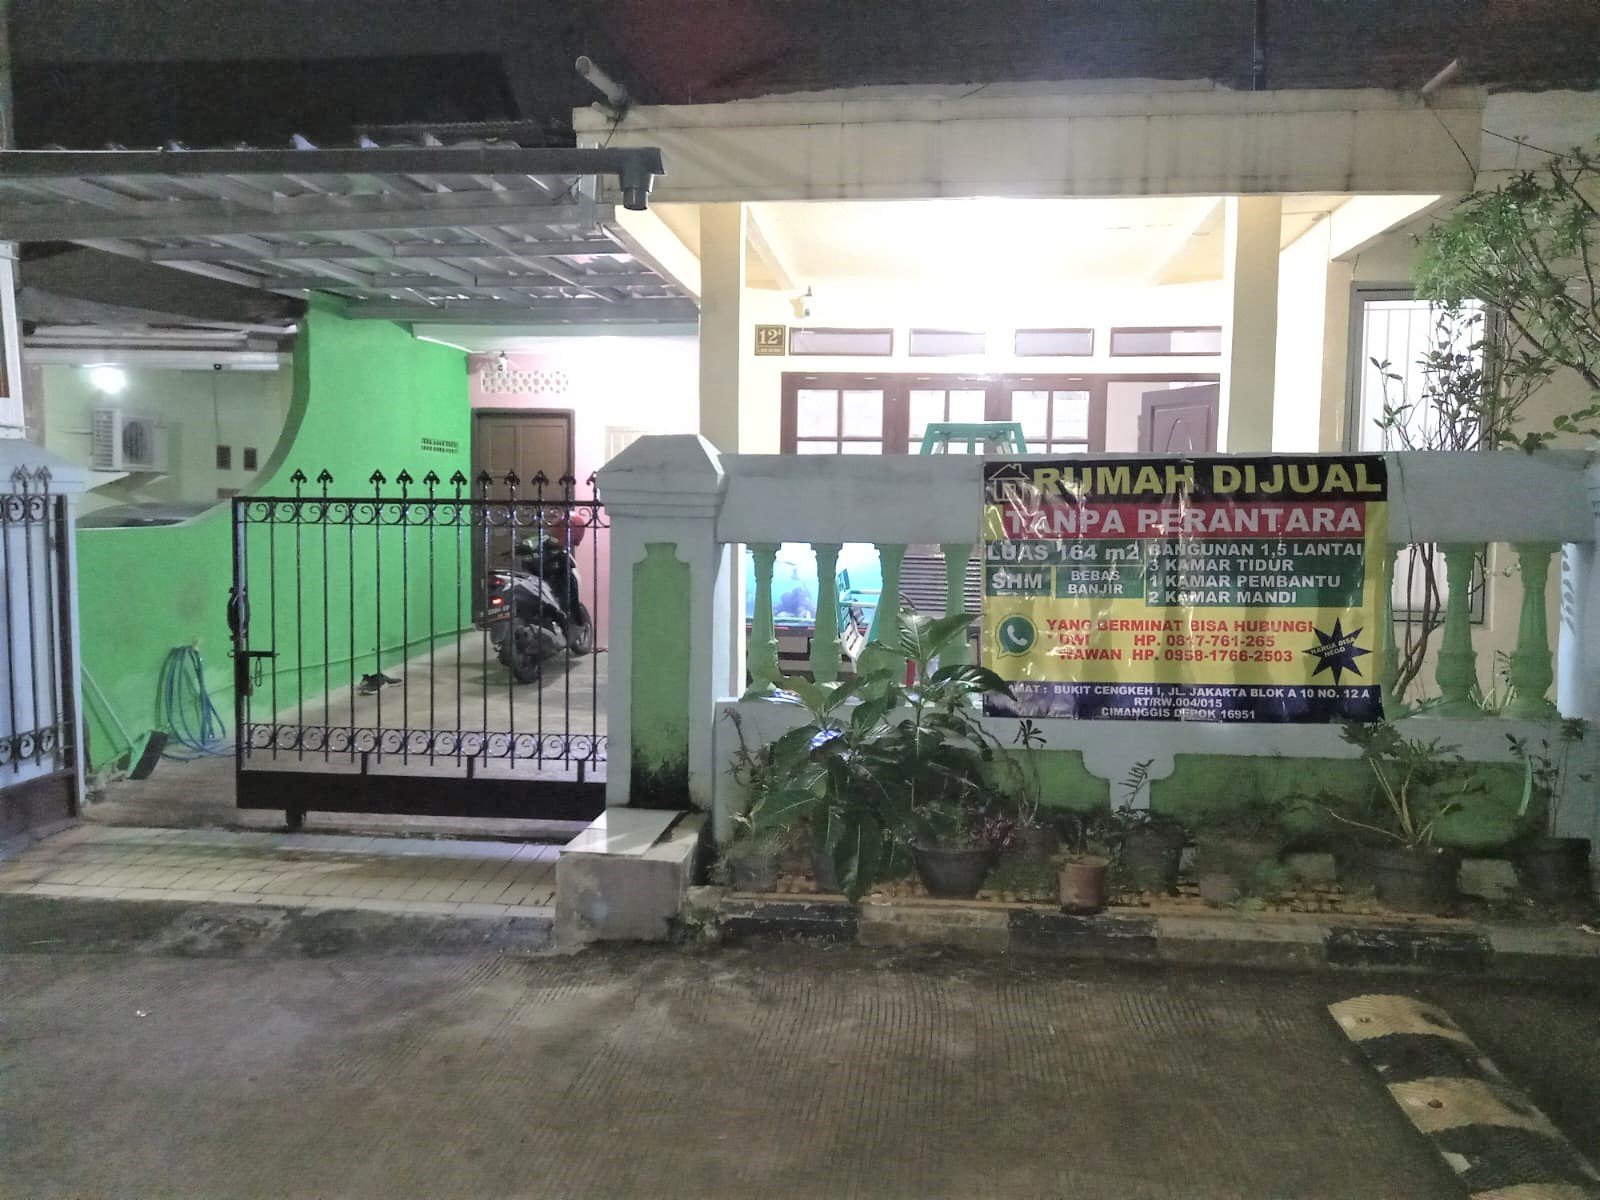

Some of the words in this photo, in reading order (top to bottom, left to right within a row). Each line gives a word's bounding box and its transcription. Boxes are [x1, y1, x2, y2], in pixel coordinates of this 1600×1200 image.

[1033, 465, 1195, 496] RUMAH
[1212, 463, 1382, 494] DIJUAL
[1005, 508, 1126, 534] TANPA
[1137, 507, 1362, 534] PERANTARA
[987, 544, 1049, 561] LUAS
[1059, 543, 1098, 561] 164
[1105, 543, 1140, 561] m2
[1150, 542, 1253, 556] BANGUNAN
[1261, 543, 1287, 559] 1,5
[1293, 543, 1362, 556] LANTAI
[1150, 560, 1160, 572] 3
[1165, 559, 1231, 572] KAMAR
[1237, 559, 1294, 572] TIDUR
[992, 573, 1042, 589] SHM
[1071, 570, 1121, 581] BEBAS
[1150, 576, 1158, 588] 1
[1165, 575, 1231, 588] KAMAR
[1237, 575, 1341, 588] PEMBANTU
[1068, 583, 1123, 595] BANJIR
[1149, 591, 1160, 603] 2
[1165, 591, 1231, 604] KAMAR
[1237, 591, 1297, 604] MANDI
[1046, 619, 1091, 631] YANG
[1097, 619, 1183, 632] BERMINAT
[1191, 620, 1228, 632] BISA
[1234, 620, 1313, 633] HUBUNGI
[1134, 635, 1161, 646] HP.
[1132, 649, 1159, 660] HP.
[1054, 685, 1091, 694] BUKIT
[1094, 686, 1153, 696] CENGKEH
[1189, 687, 1247, 698] JAKARTA
[1250, 688, 1285, 698] BLOK
[1287, 688, 1297, 698] A
[1300, 688, 1314, 698] 10
[1317, 689, 1340, 698] NO.
[1344, 689, 1359, 698] 12
[1361, 689, 1370, 698] A
[1134, 697, 1223, 708] RT/RW.004/015
[1101, 707, 1171, 717] CIMANGGIS
[1174, 708, 1217, 719] DEPOK
[1220, 709, 1256, 719] 16951
